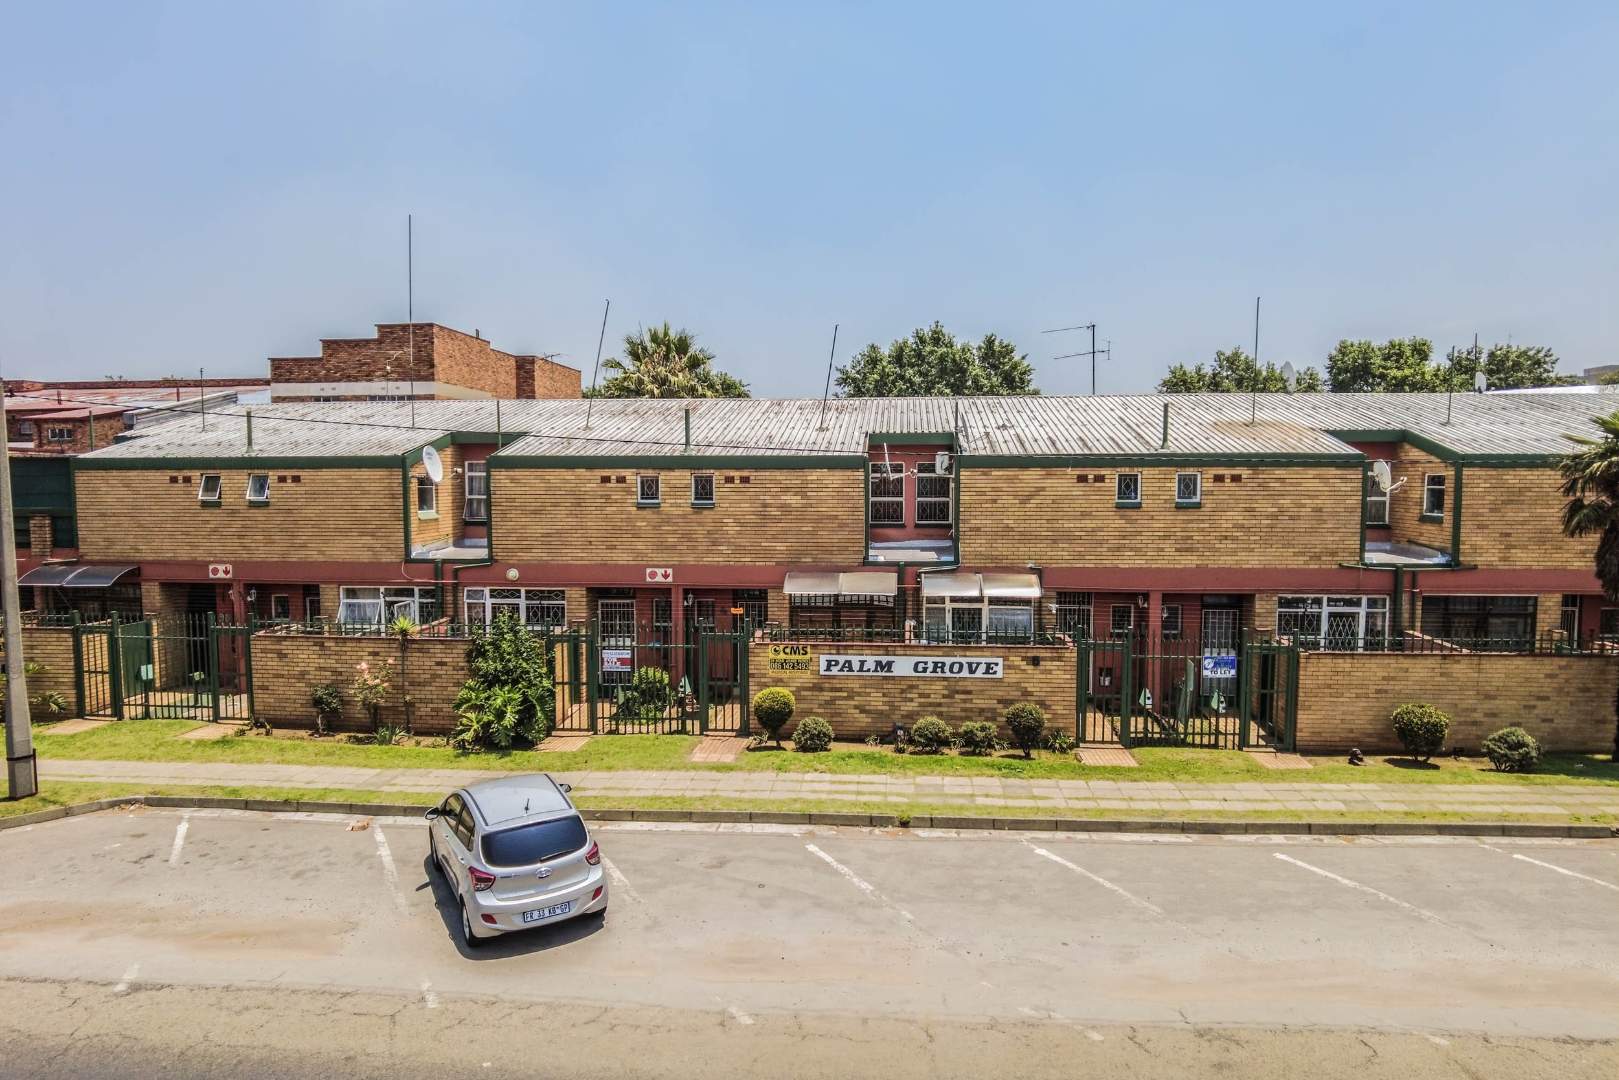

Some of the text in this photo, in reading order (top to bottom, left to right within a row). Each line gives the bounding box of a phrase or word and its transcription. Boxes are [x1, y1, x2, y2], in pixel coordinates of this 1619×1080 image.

[782, 646, 809, 656] CMS
[824, 659, 999, 675] PALM GROVE
